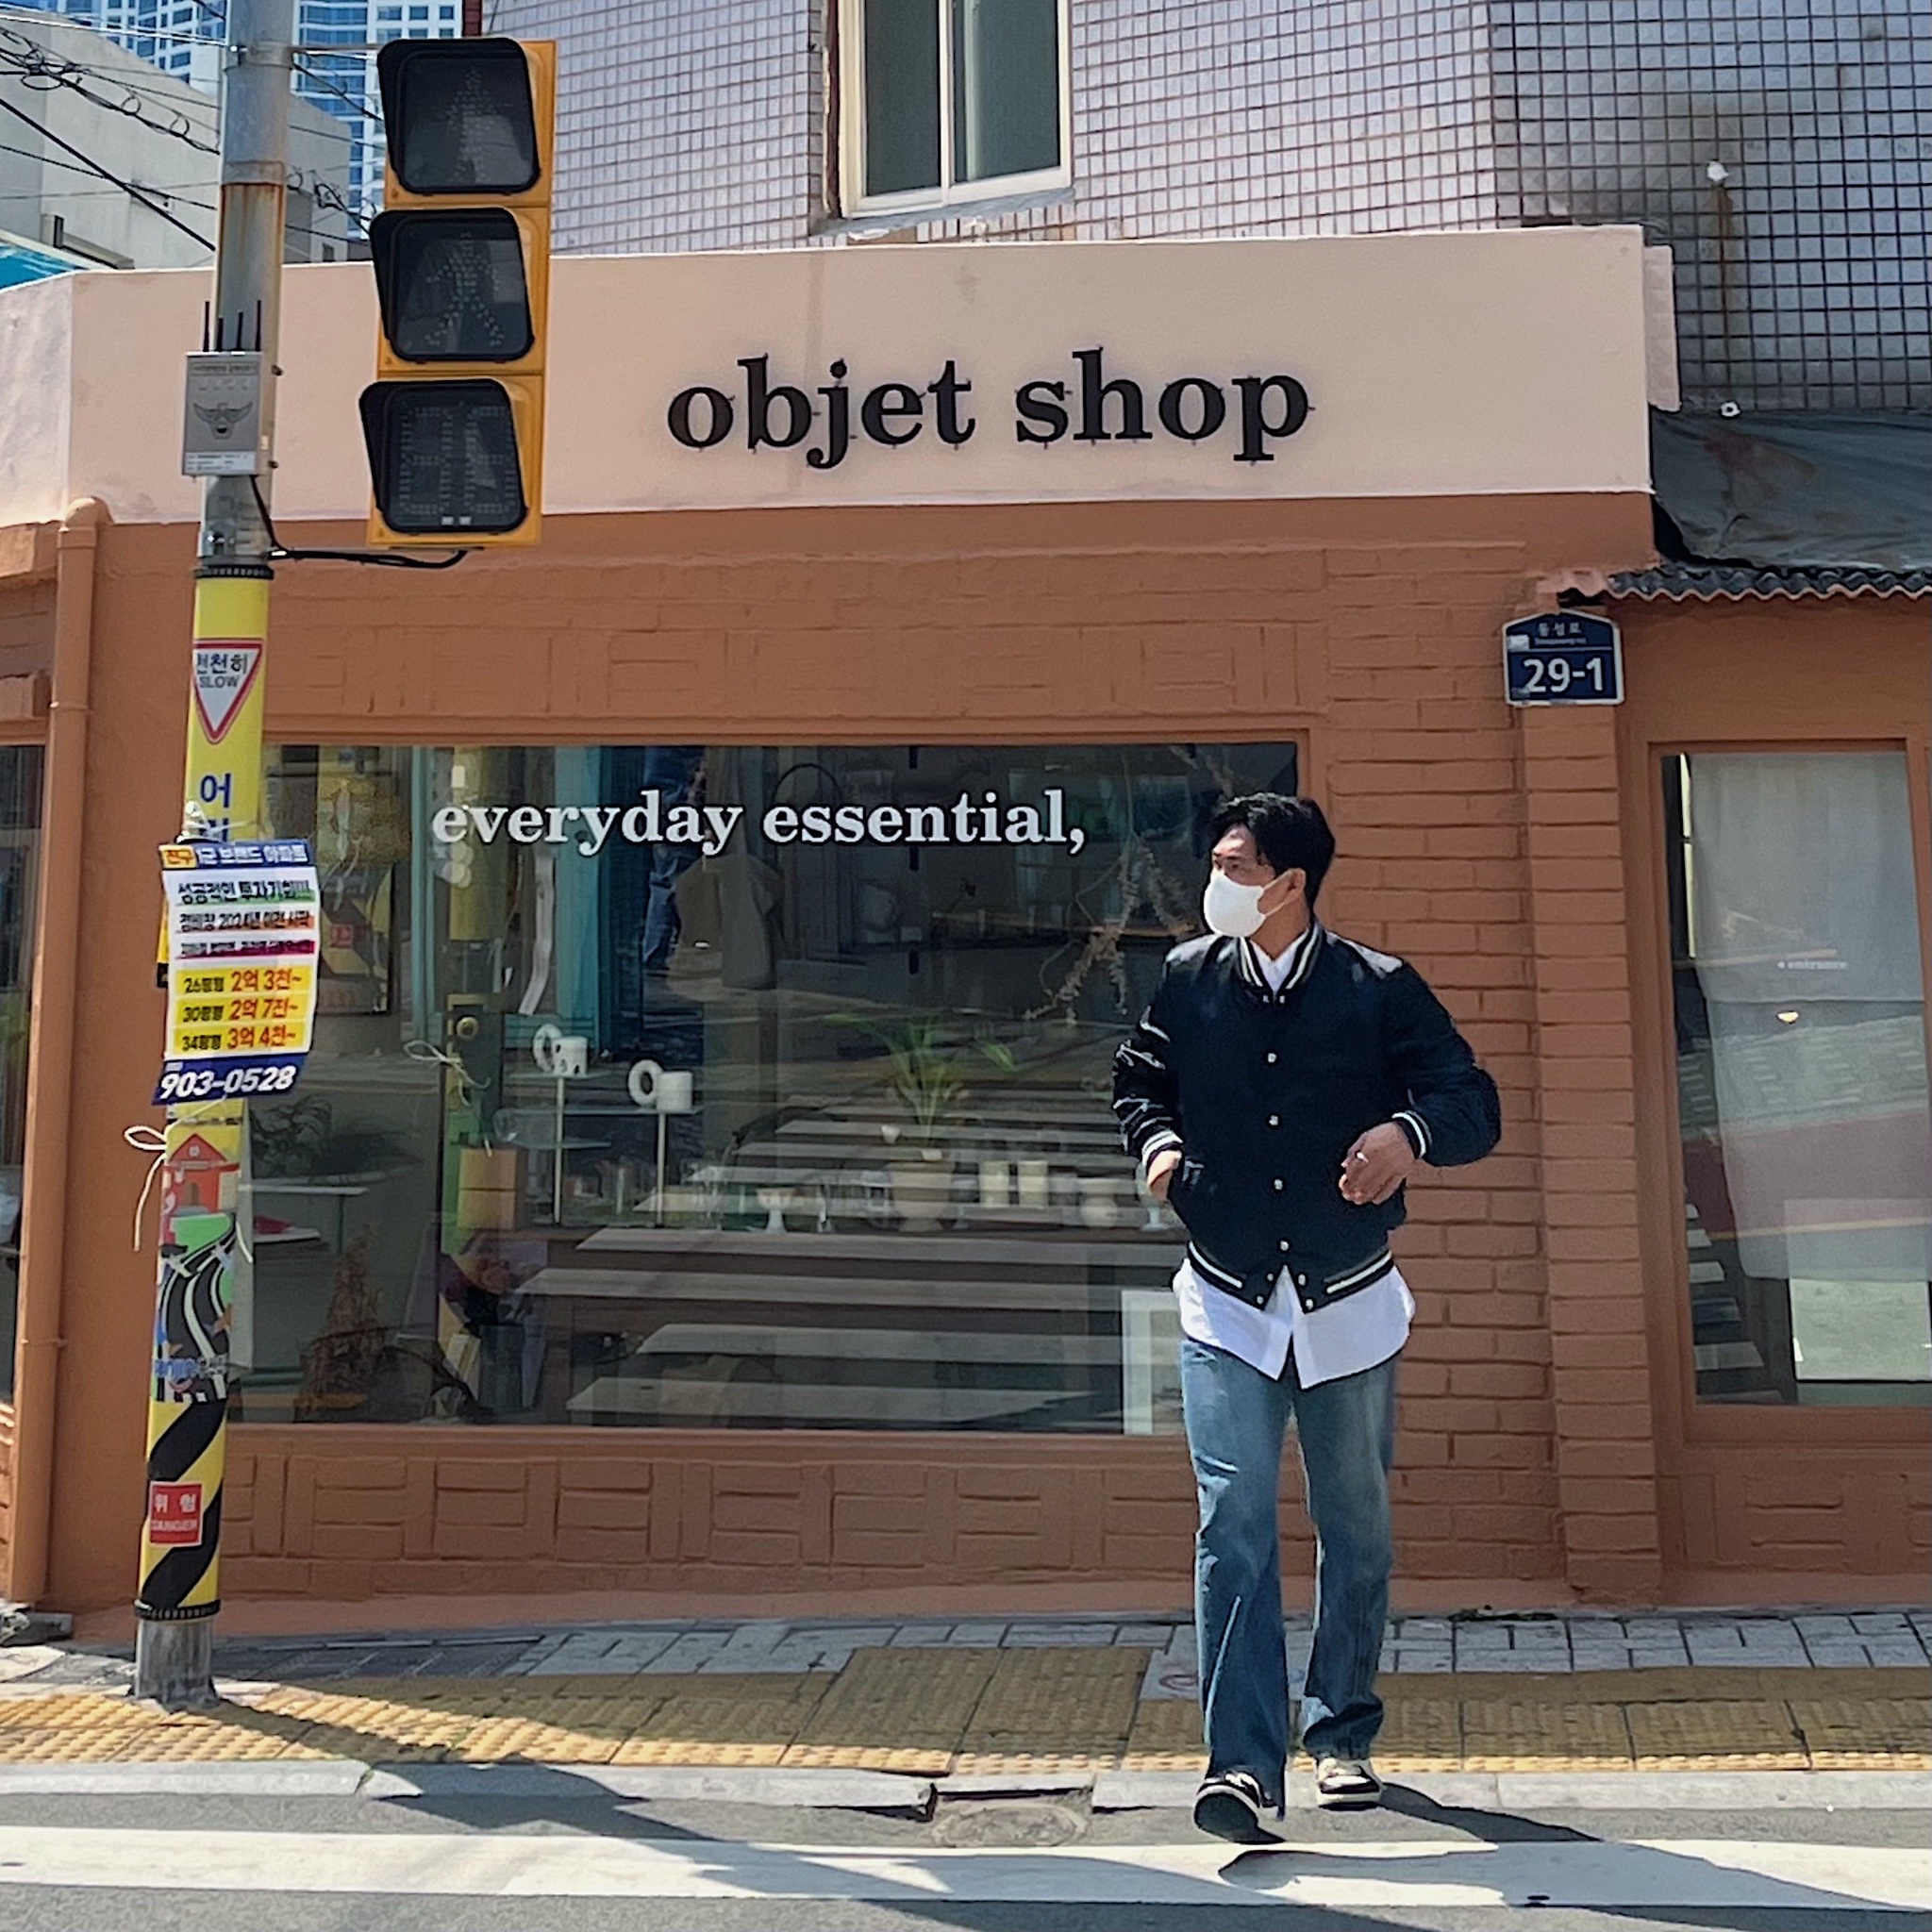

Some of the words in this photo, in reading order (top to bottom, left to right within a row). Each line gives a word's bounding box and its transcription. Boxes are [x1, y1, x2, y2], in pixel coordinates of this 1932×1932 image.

[667, 354, 975, 469] objet
[1016, 347, 1310, 461] shop
[199, 676, 240, 689] SLOW
[1524, 658, 1604, 693] 29-1
[432, 790, 742, 856] everyday
[762, 789, 1085, 855] essential,
[220, 846, 263, 862] 브랜드
[265, 844, 308, 862] 아파트
[178, 881, 236, 905] 성공적인
[231, 969, 259, 992] 2억
[228, 998, 258, 1022] 2억
[226, 1026, 256, 1050] 3억
[159, 1065, 297, 1100] 903-0528
